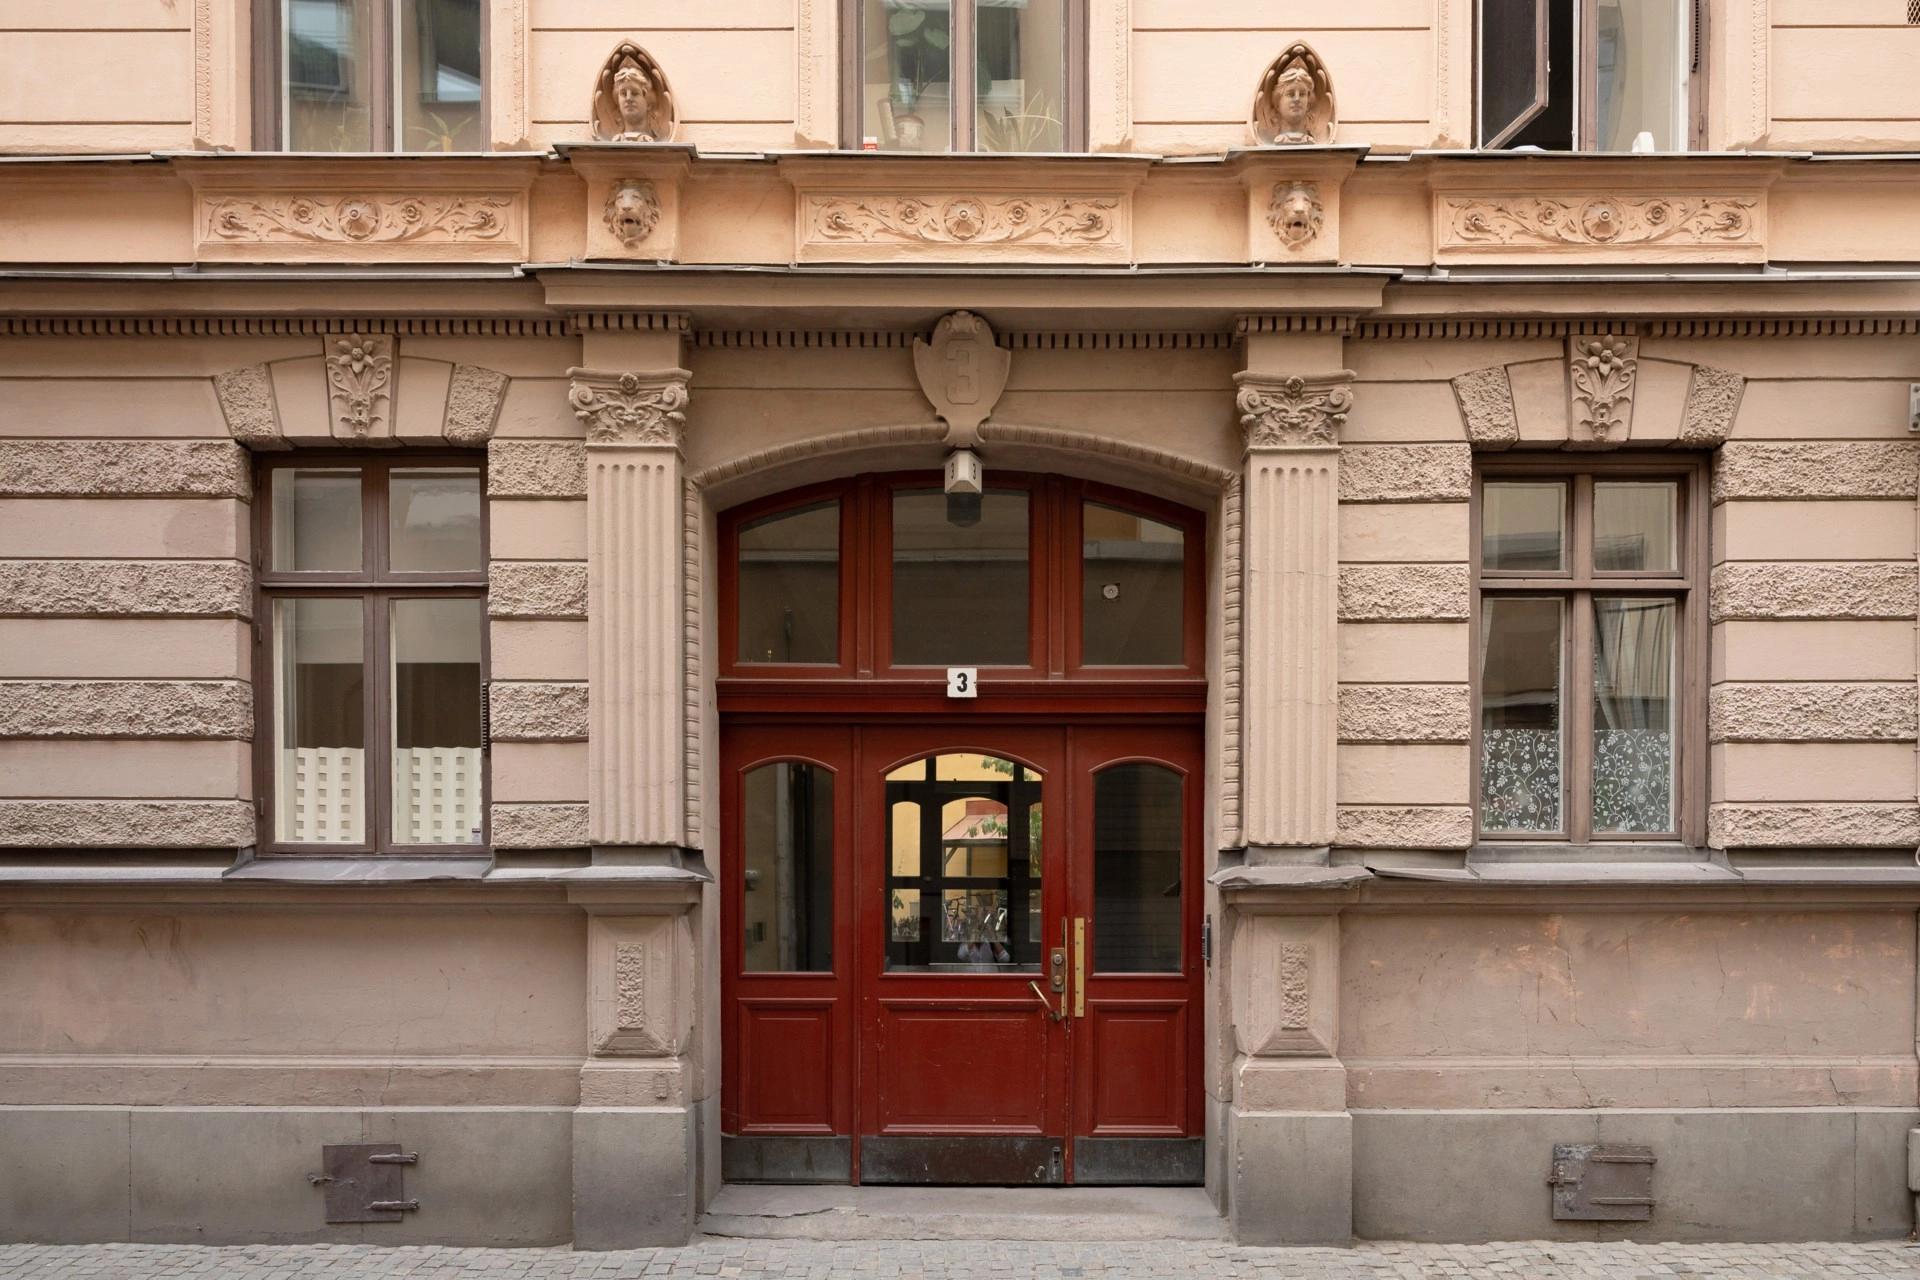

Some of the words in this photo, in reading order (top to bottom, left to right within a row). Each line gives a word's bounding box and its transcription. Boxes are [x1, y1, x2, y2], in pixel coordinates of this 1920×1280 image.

[946, 339, 979, 405] 3
[973, 463, 977, 480] 3
[957, 672, 968, 693] 3
